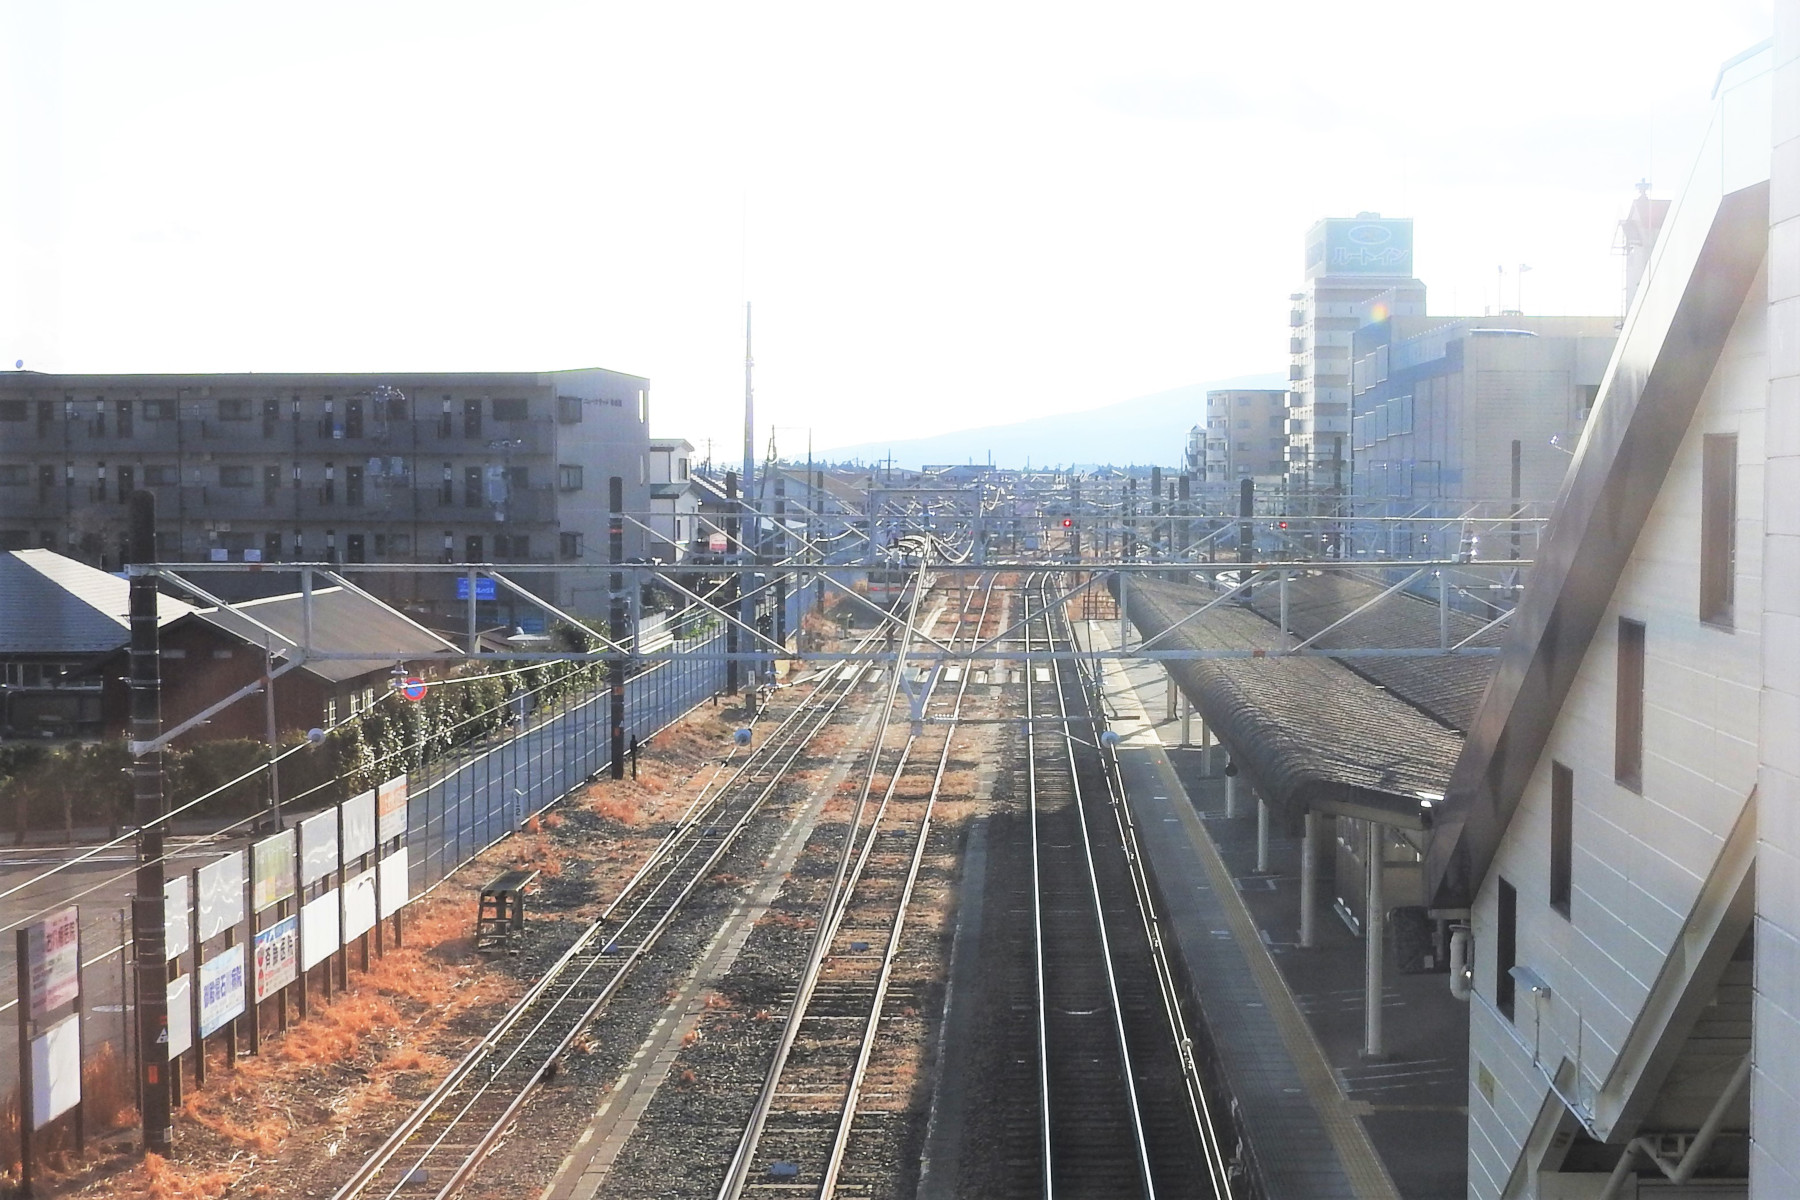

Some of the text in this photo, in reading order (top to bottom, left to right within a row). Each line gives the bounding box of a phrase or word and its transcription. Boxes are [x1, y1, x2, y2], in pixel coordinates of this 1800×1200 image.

[1331, 246, 1409, 266] ルートイン
